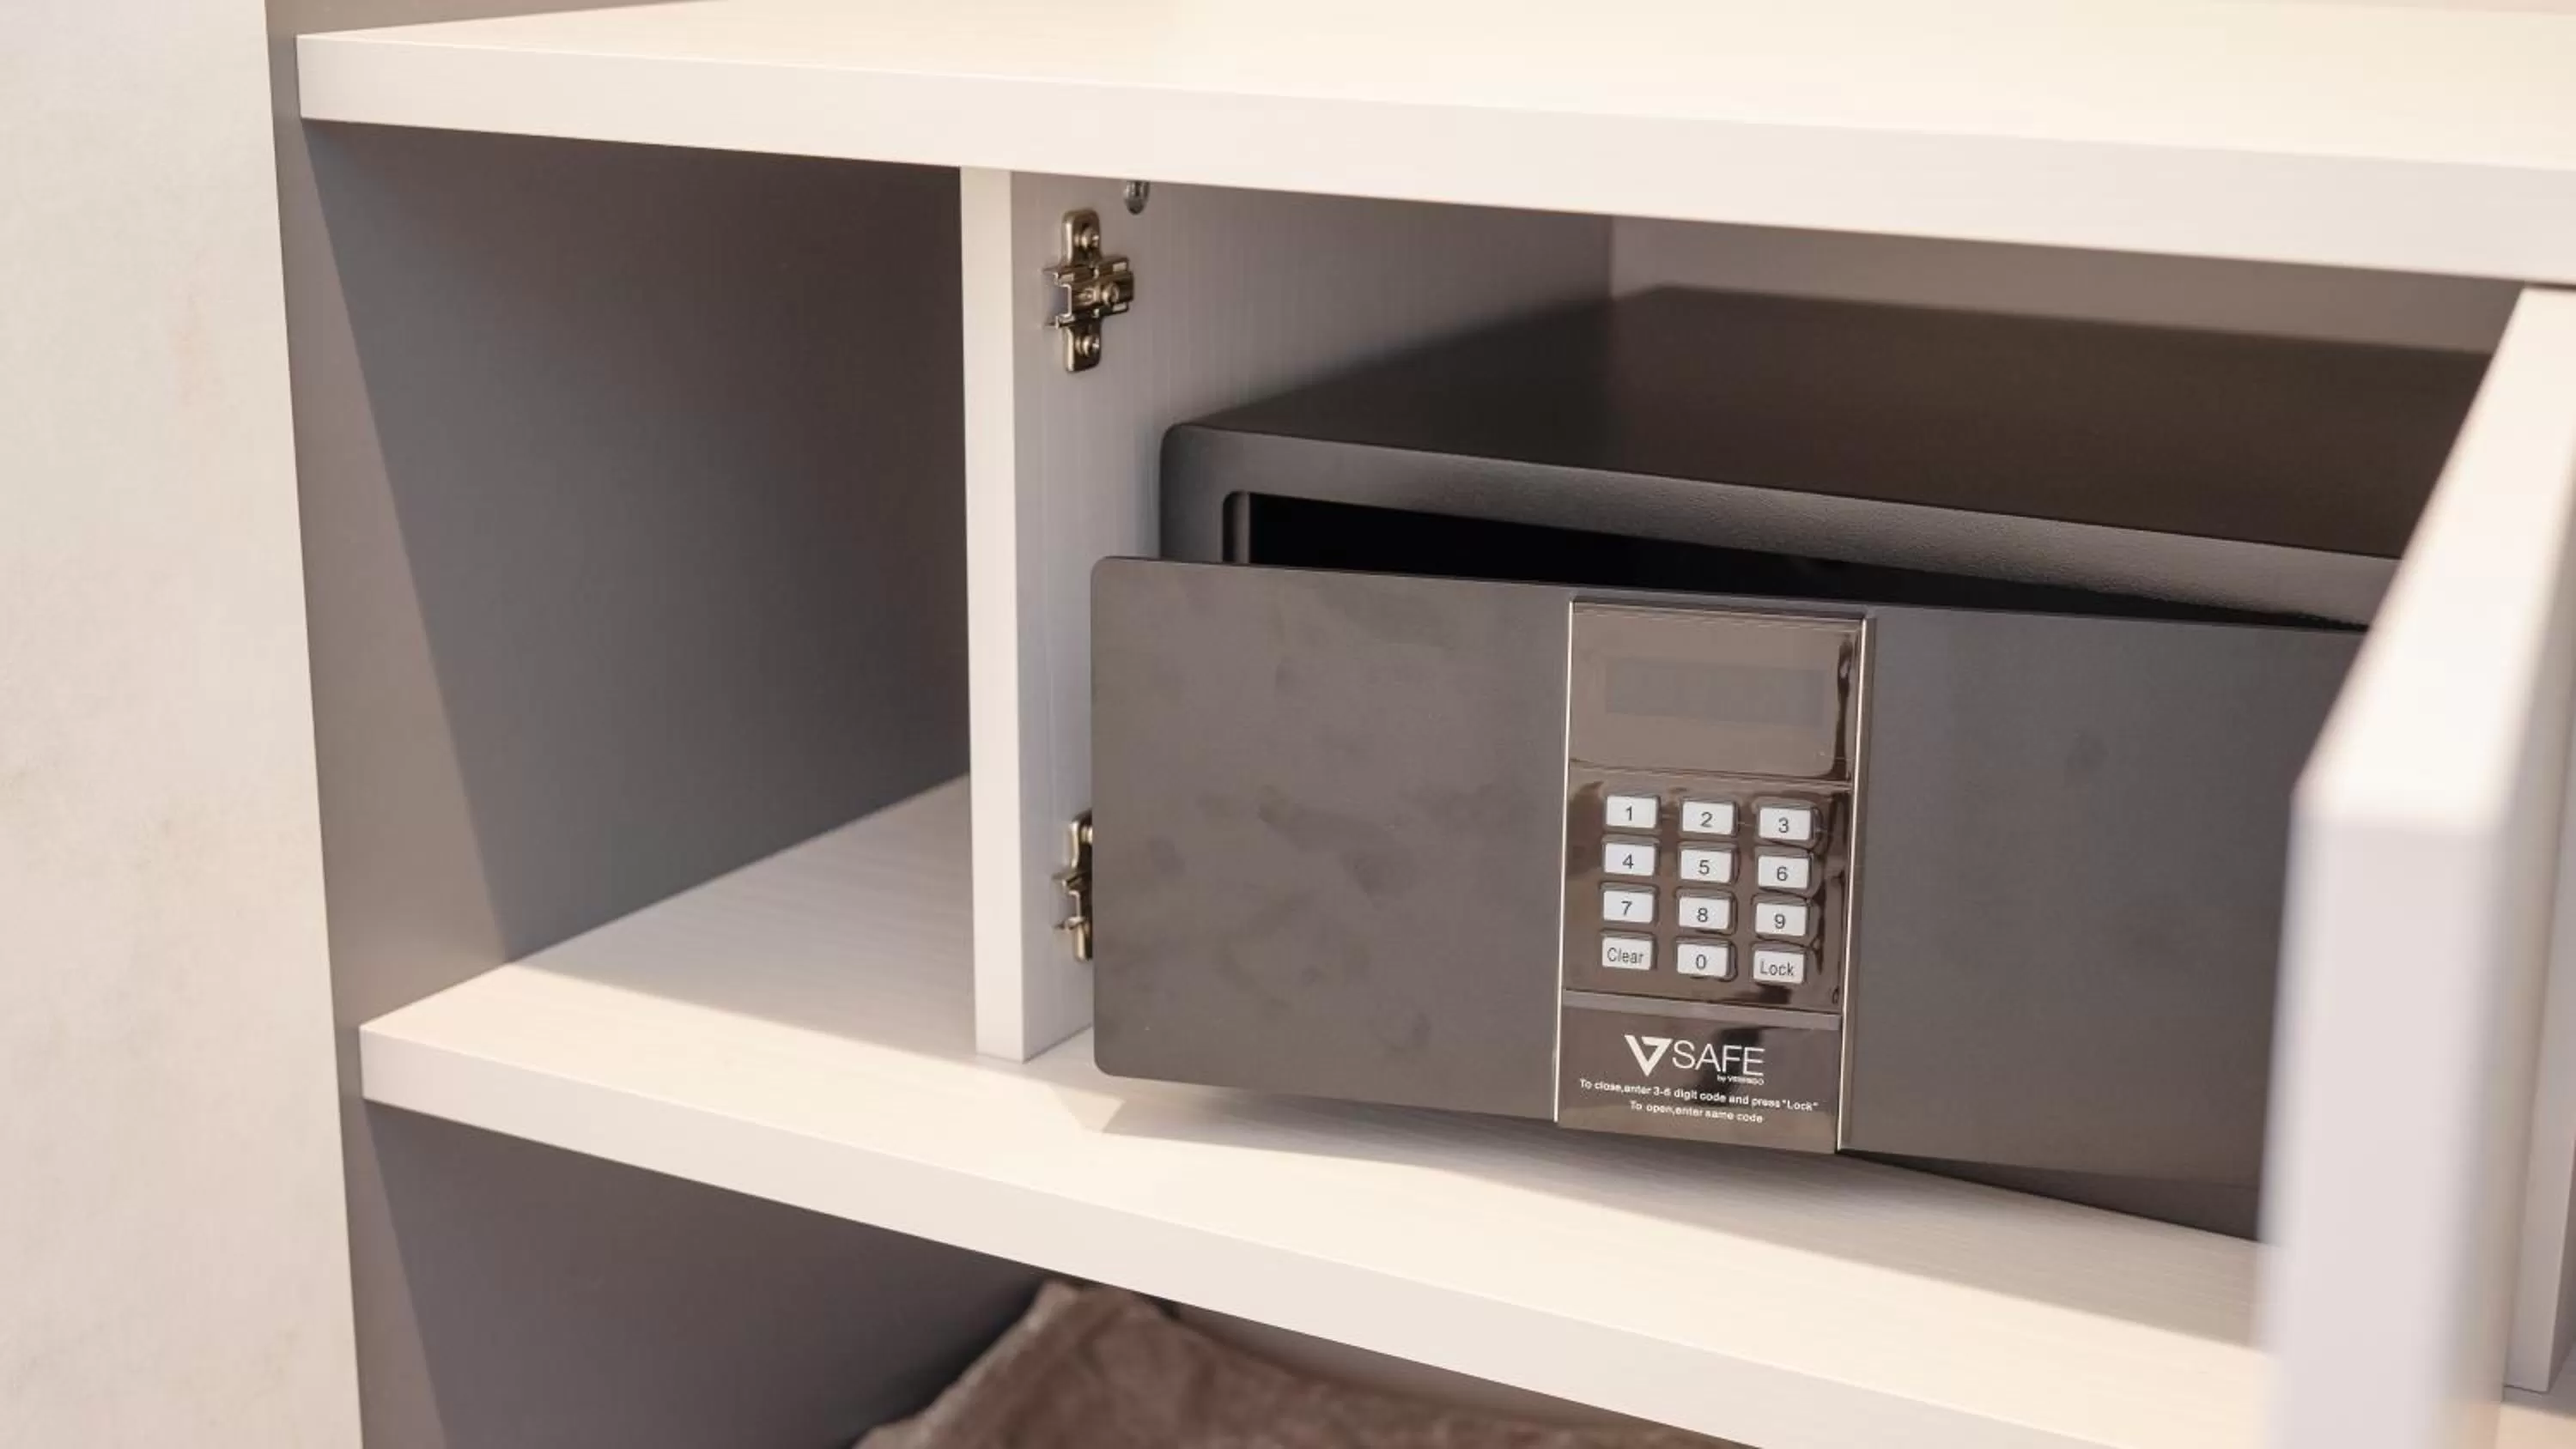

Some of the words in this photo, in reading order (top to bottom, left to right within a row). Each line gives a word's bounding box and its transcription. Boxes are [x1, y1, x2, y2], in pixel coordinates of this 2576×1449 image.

[1625, 805, 1633, 821] 1
[1699, 811, 1713, 828] 2
[1777, 817, 1789, 834] 3
[1622, 854, 1634, 869] 4
[1698, 859, 1710, 875] 5
[1776, 866, 1789, 882] 6
[1621, 900, 1632, 916] 7
[1696, 907, 1709, 923] 8
[1773, 913, 1786, 930] 9
[1607, 947, 1643, 964] Clear
[1696, 955, 1707, 970] 0
[1759, 961, 1795, 977] Lock
[1580, 1078, 1593, 1089] To
[1653, 1086, 1671, 1097] 3-6
[1674, 1088, 1698, 1101] digit
[1699, 1092, 1727, 1103] code
[1728, 1094, 1749, 1106] and
[1751, 1098, 1781, 1109] press
[1630, 1100, 1643, 1111] To
[1704, 1108, 1735, 1120] same
[1736, 1113, 1764, 1124] code
